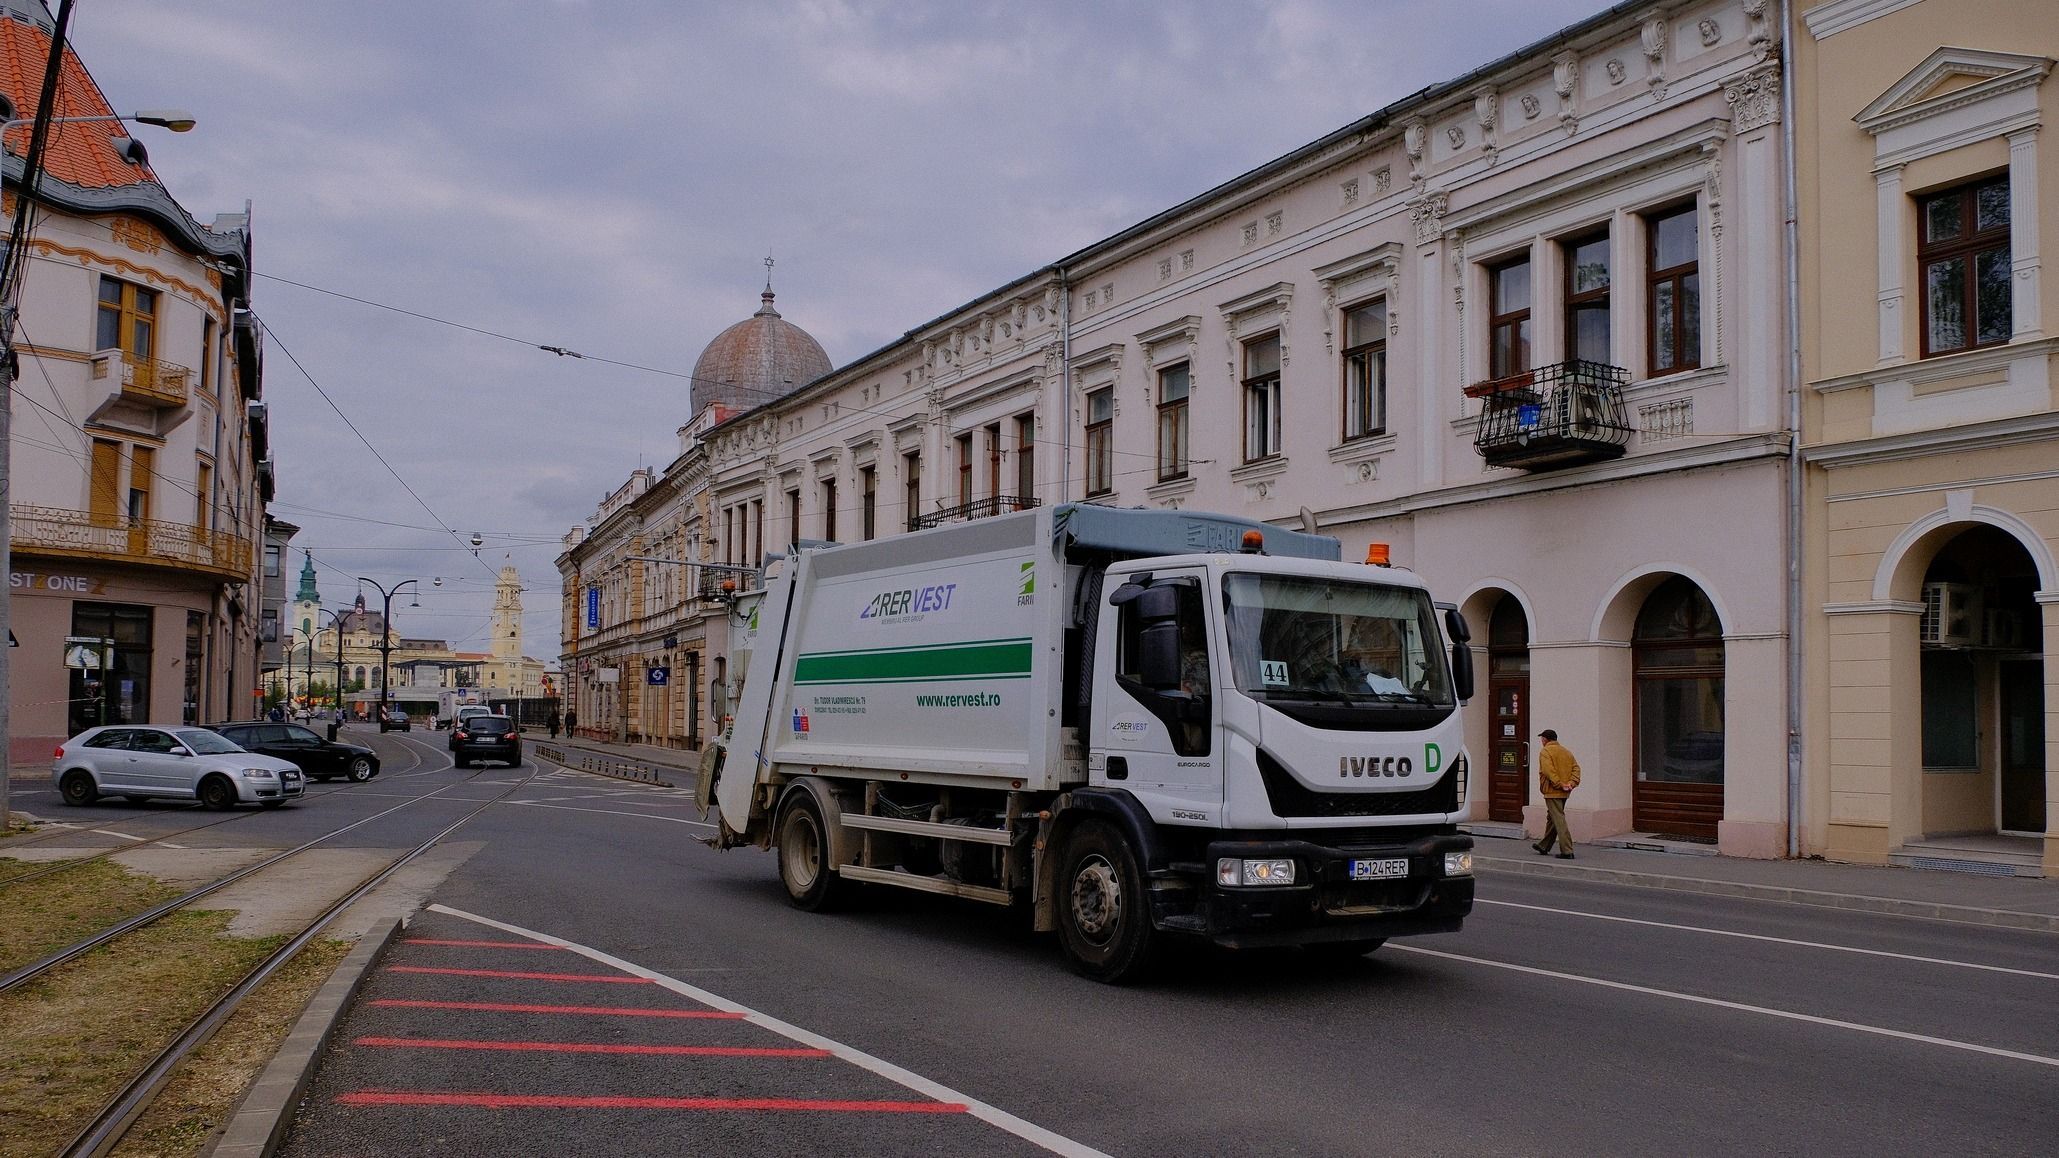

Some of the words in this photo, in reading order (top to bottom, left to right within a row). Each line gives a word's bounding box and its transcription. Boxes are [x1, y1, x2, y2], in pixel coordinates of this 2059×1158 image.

[1208, 524, 1243, 552] FARI
[1264, 664, 1287, 682] 44
[916, 691, 1000, 707] www.rervest.ro
[1340, 757, 1412, 777] IVECO
[1425, 743, 1441, 773] D
